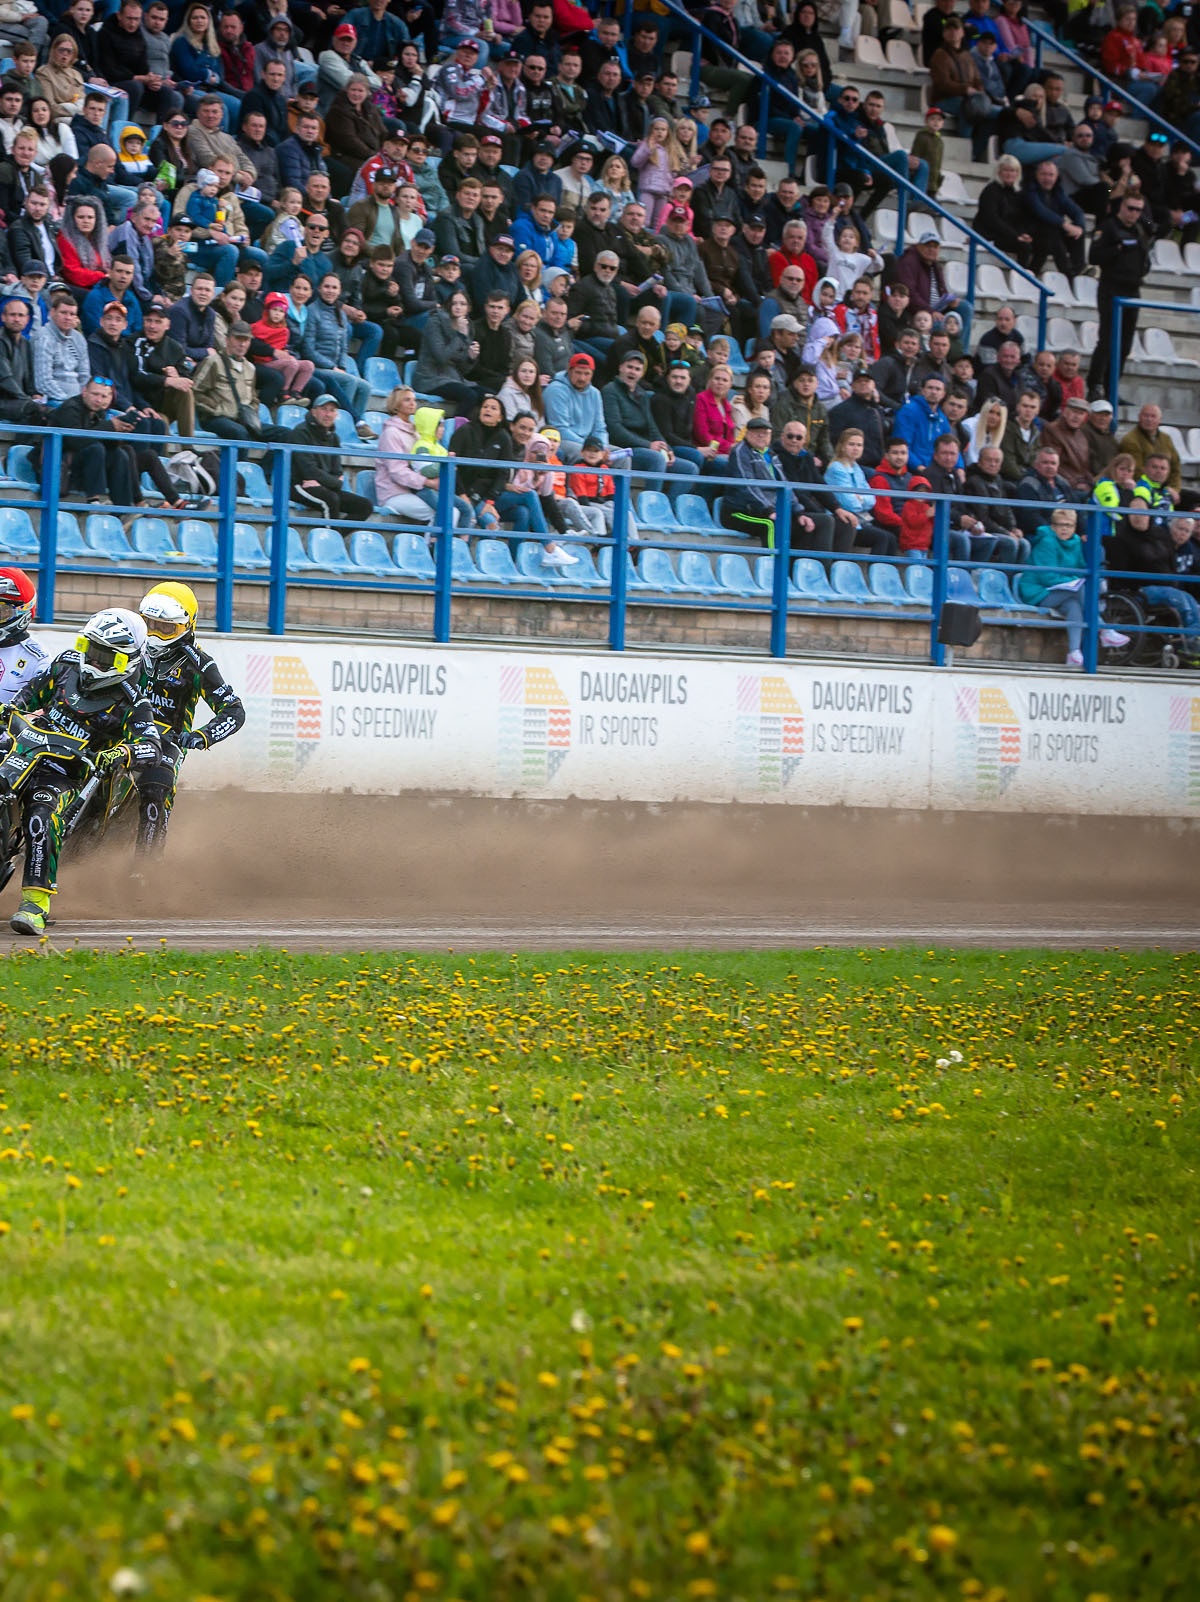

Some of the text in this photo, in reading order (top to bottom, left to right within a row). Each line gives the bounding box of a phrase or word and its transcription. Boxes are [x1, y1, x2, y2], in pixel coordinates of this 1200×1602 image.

[331, 660, 447, 696] DAUGAVPILS
[579, 670, 689, 706] DAUGAVPILS
[812, 680, 913, 715] DAUGAVPILS
[1028, 691, 1126, 724] DAUGAVPILS
[330, 705, 438, 741] IS SPEEDWAY
[579, 715, 659, 748] IR SPORTS
[811, 723, 905, 756] IS SPEEDWAY
[1027, 732, 1099, 764] IR SPORTS
